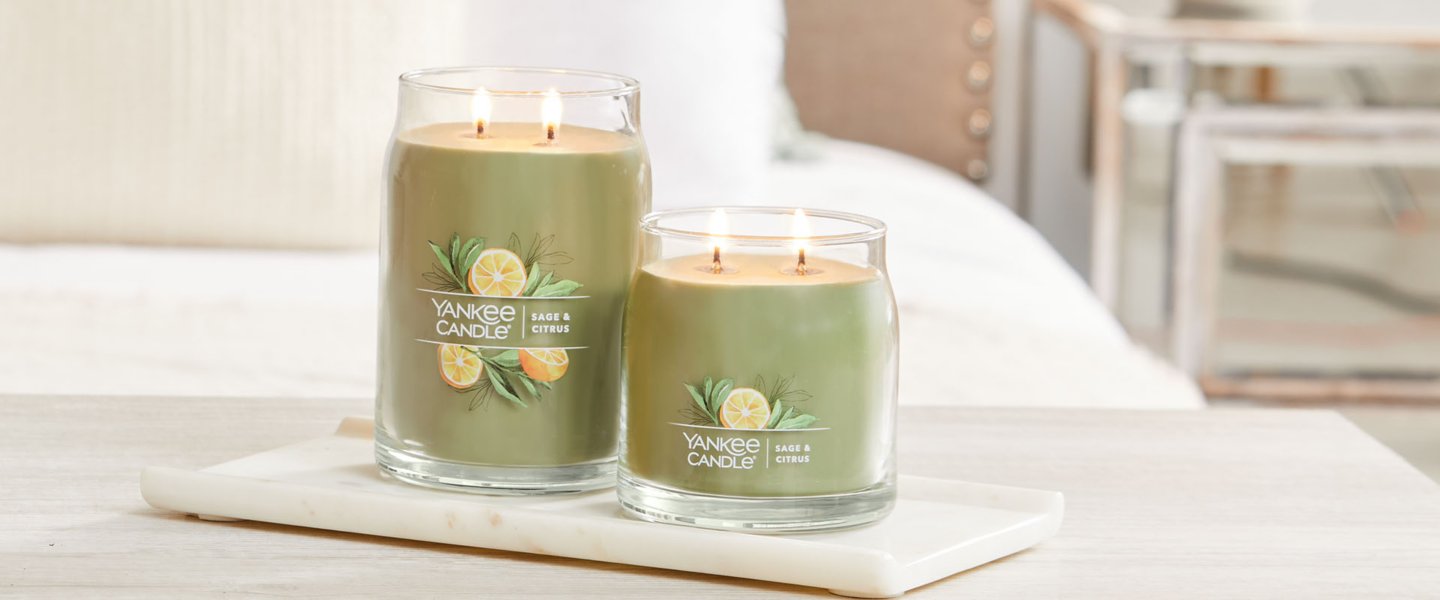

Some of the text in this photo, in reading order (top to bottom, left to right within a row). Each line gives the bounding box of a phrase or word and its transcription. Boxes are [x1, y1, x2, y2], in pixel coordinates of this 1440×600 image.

[531, 312, 571, 321] SAGE &
[531, 324, 570, 334] CITRUS
[775, 444, 811, 452] SAGE &
[775, 455, 810, 463] CITRUS
